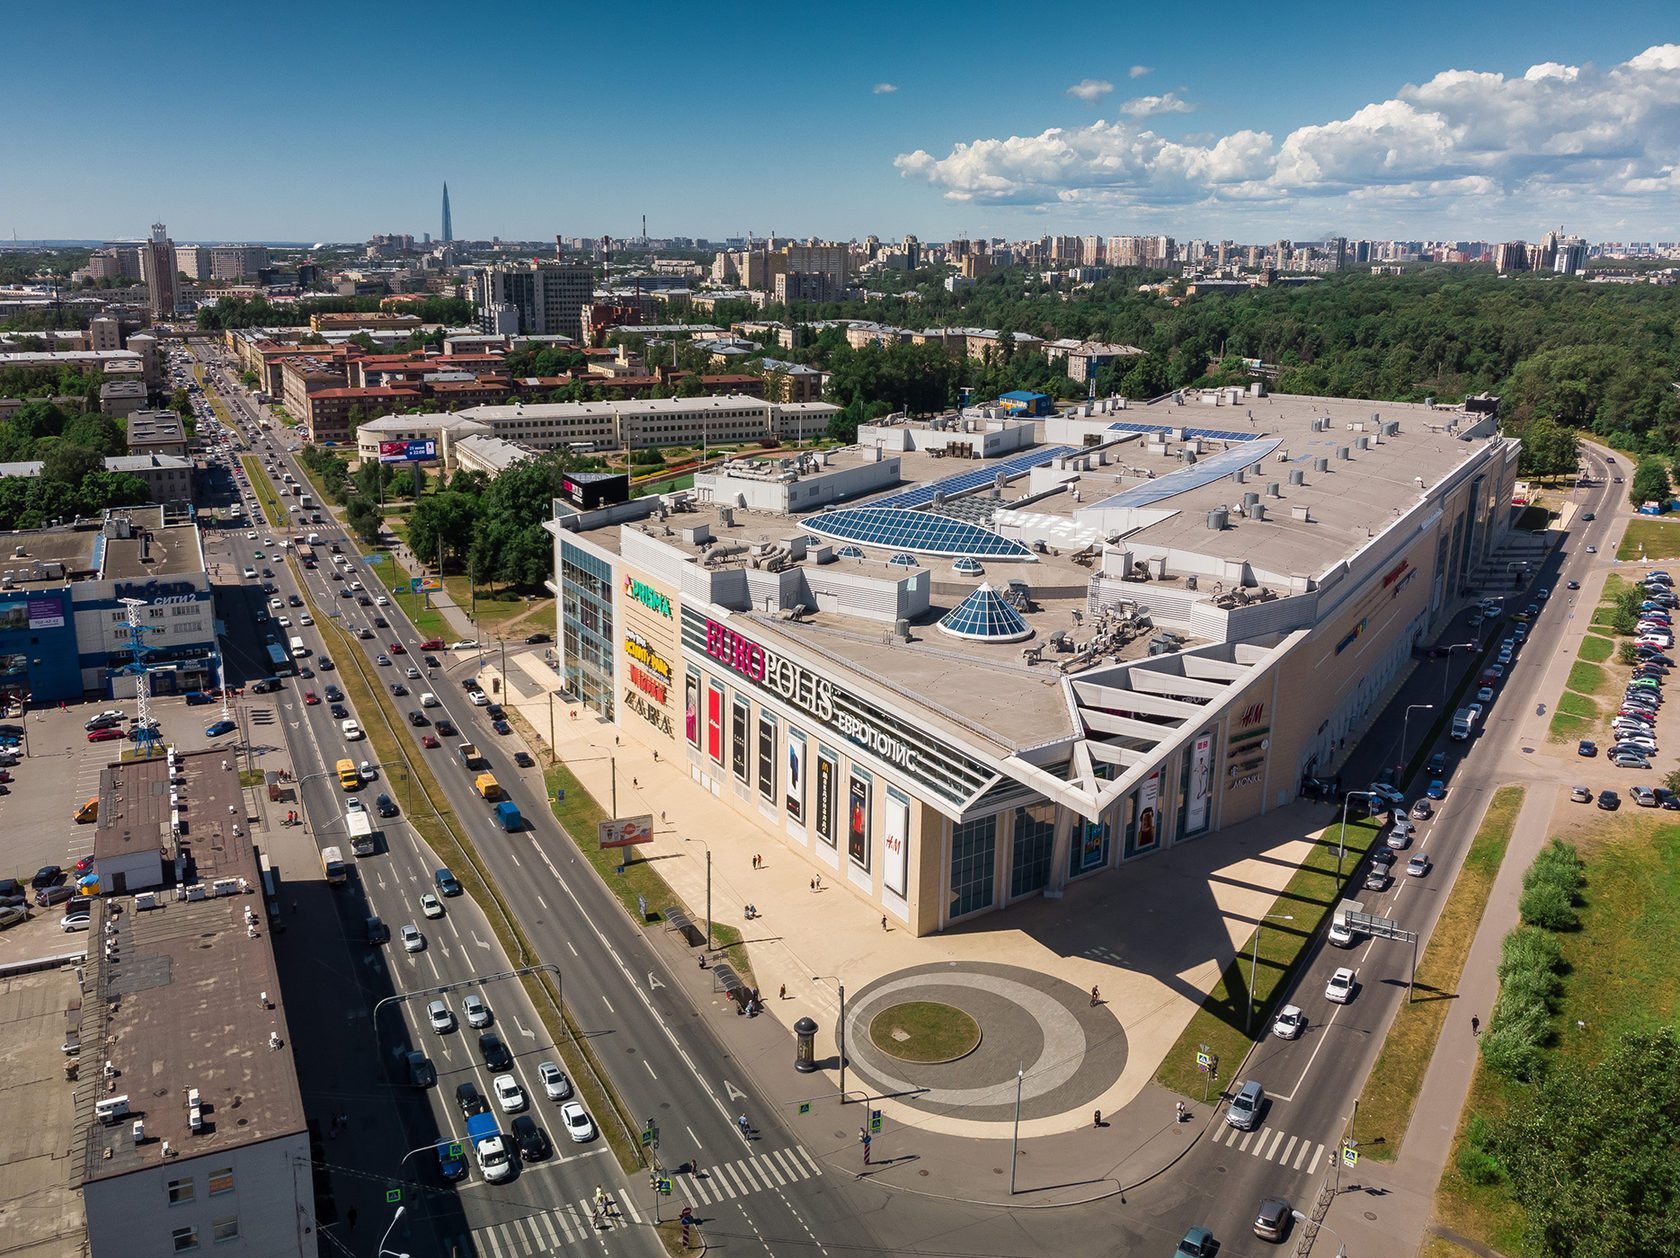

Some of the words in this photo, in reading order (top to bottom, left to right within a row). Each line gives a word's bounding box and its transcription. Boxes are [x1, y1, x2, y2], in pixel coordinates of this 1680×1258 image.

[632, 578, 671, 617] PRISMA
[706, 618, 834, 722] EUROPOLIS
[624, 687, 673, 739] ZARA
[837, 711, 918, 772] ЕВРОПОЛИС
